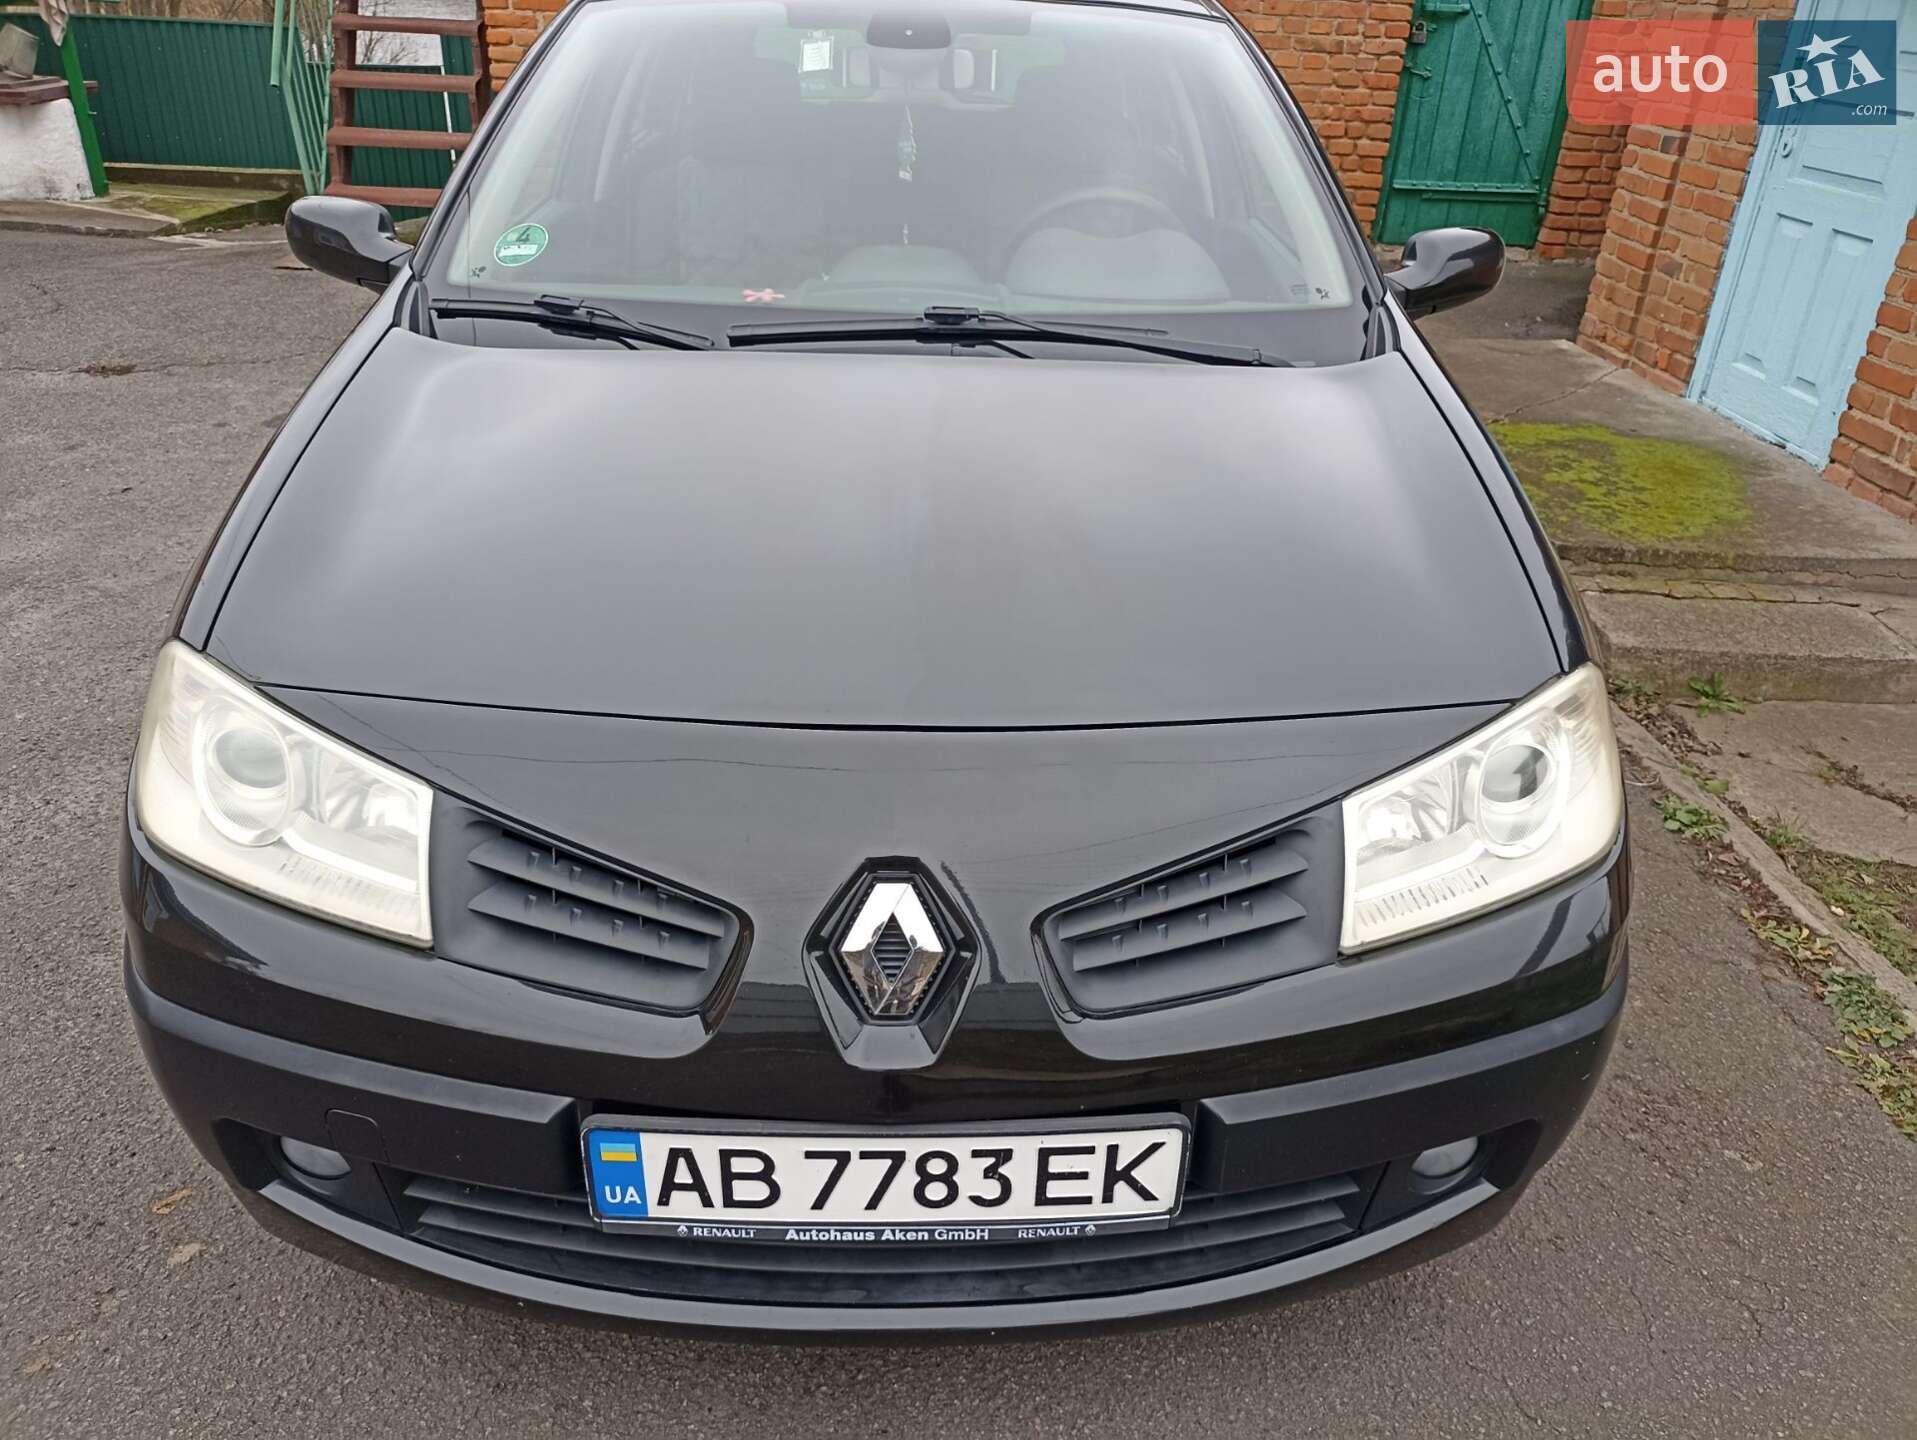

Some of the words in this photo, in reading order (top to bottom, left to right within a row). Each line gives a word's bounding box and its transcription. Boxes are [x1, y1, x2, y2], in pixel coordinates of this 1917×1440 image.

[657, 1147, 782, 1209] AB
[803, 1148, 1014, 1211] 7783
[1034, 1141, 1167, 1206] EK
[605, 1186, 642, 1204] UA
[693, 1226, 757, 1239] RENAULT
[785, 1228, 876, 1241] Autohaus
[881, 1228, 928, 1241] Aken
[934, 1227, 990, 1241] GmbH
[1018, 1226, 1081, 1239] RENAULT
